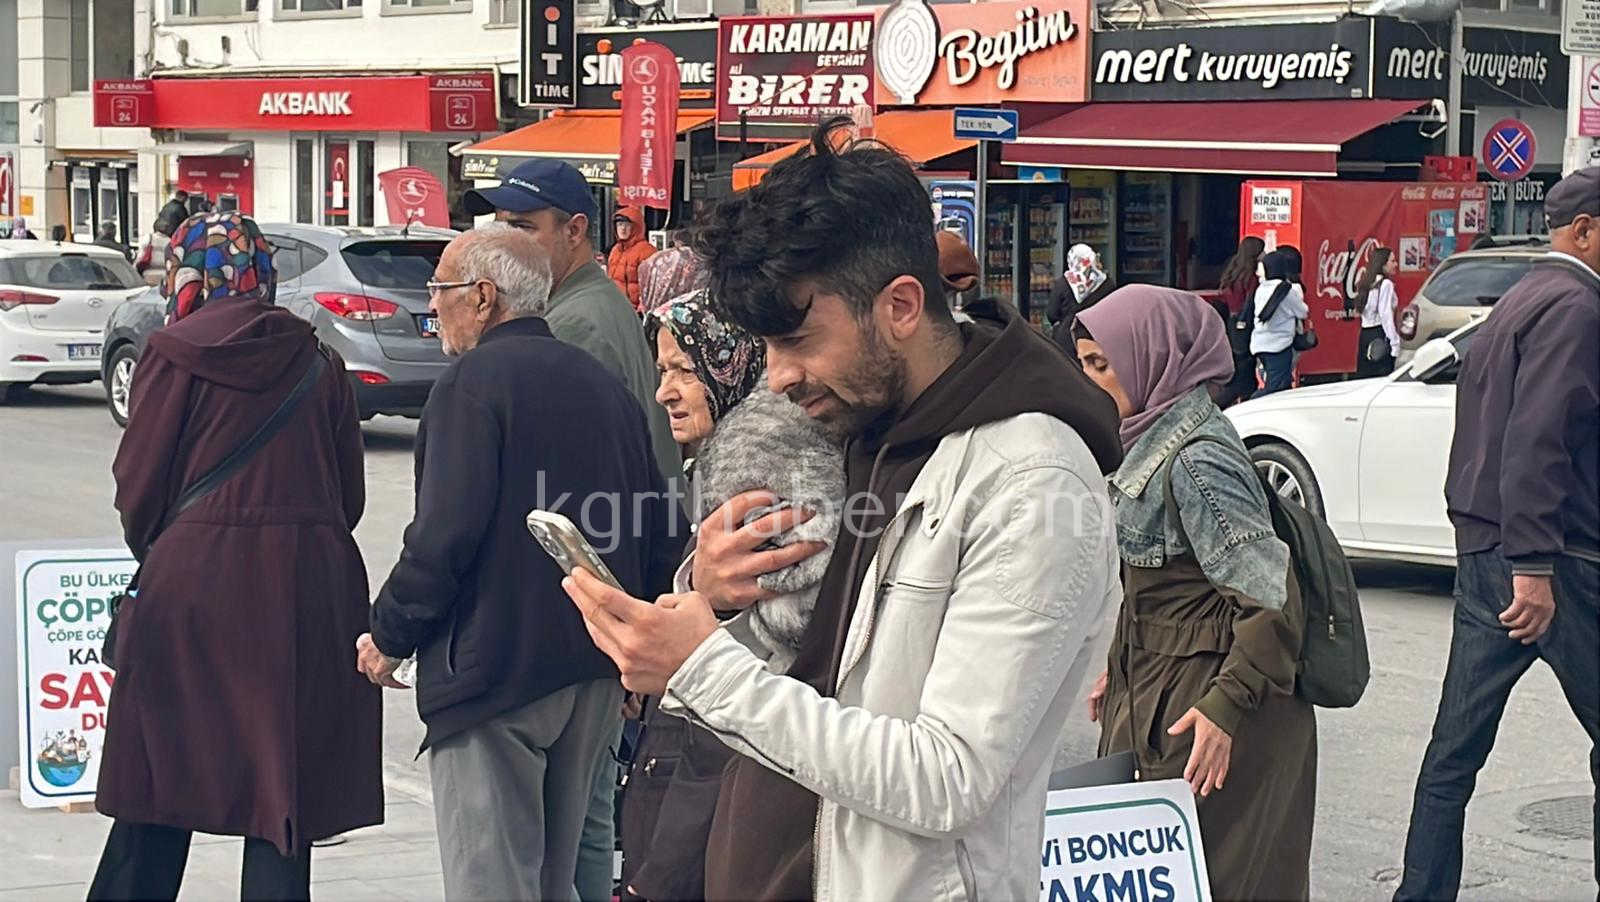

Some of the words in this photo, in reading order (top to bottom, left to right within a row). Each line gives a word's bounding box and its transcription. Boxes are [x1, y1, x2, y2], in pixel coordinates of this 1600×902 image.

[729, 21, 872, 53] KARAMAN
[1095, 43, 1191, 83] mert
[1196, 43, 1352, 89] kuruyemiş
[1387, 46, 1445, 80] mert
[1461, 49, 1548, 86] kuruyemiş
[103, 82, 146, 91] AKBANK
[435, 78, 484, 89] AKBANK
[728, 74, 870, 106] BİRER
[258, 91, 352, 116] AKBANK
[118, 112, 131, 122] 24
[453, 113, 468, 125] 24
[961, 119, 975, 129] TEK
[977, 120, 993, 130] YÖN
[1515, 177, 1545, 201] BÜFE
[1254, 194, 1290, 207] KİRALIK
[428, 318, 441, 331] 70
[60, 575, 82, 588] BU
[87, 571, 133, 587] ÜLKE
[48, 630, 83, 643] ÇÖPE
[86, 627, 106, 641] GÖ
[69, 648, 102, 665] KA
[1041, 838, 1062, 867] Vİ
[1068, 825, 1184, 864] BONCUK
